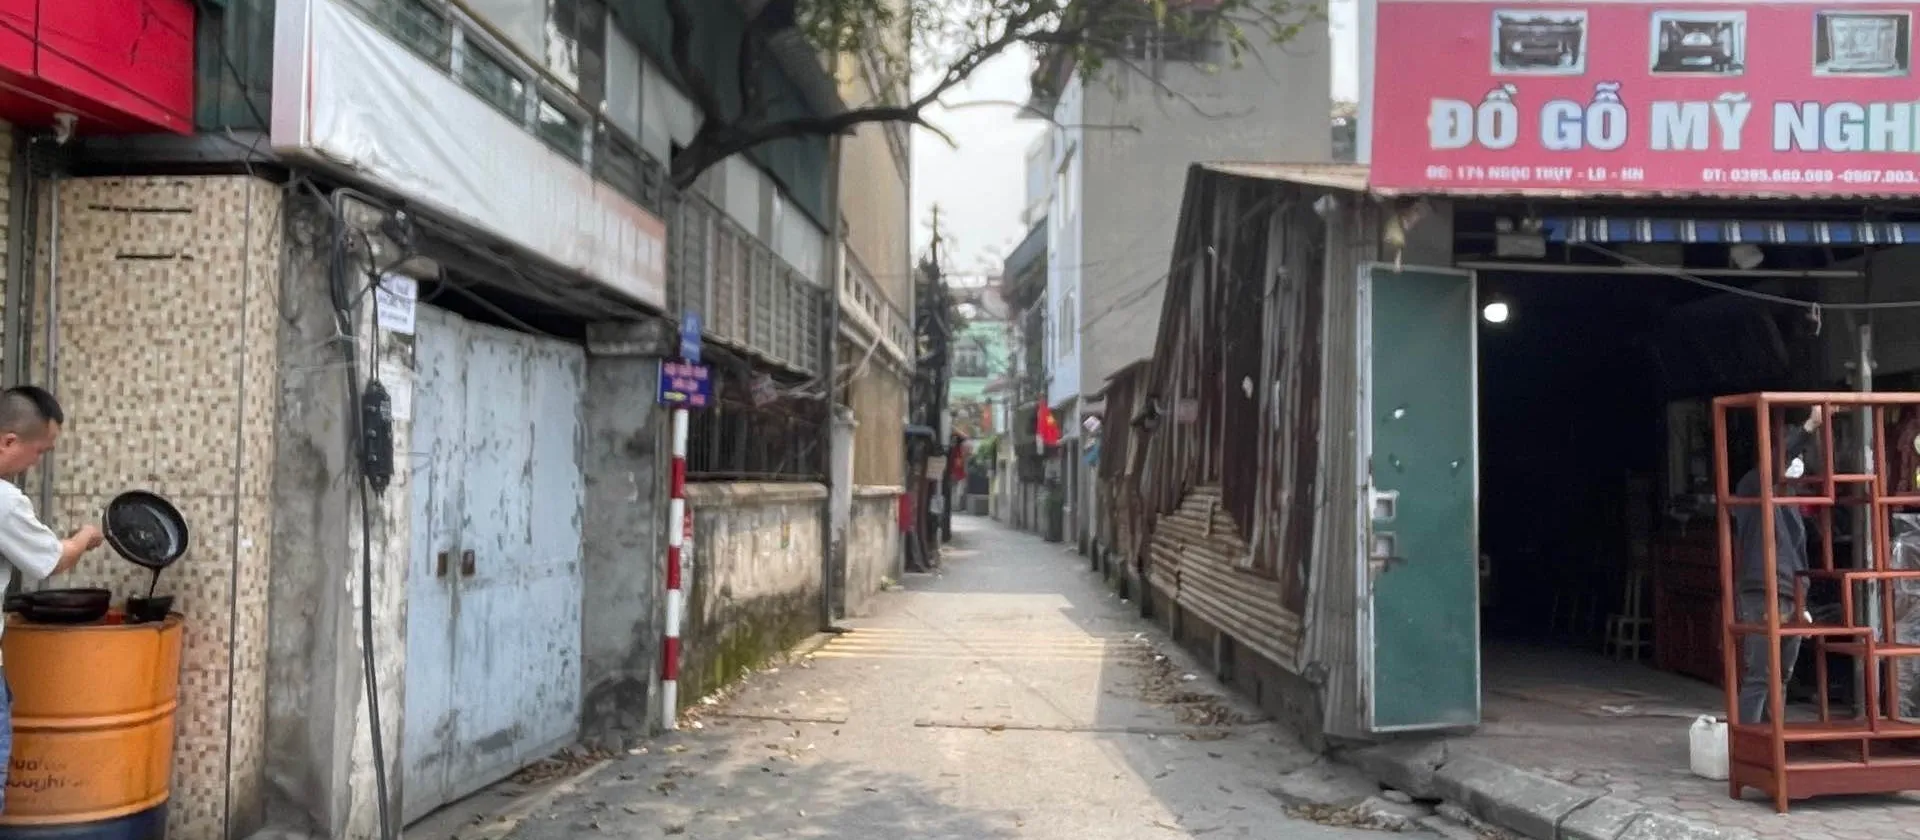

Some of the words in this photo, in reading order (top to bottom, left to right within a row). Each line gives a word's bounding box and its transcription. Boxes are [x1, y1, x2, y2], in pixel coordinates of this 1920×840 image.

[1427, 82, 1519, 151] ĐỒ
[1540, 81, 1630, 151] GỖ
[1649, 90, 1752, 151] MỸ
[1772, 101, 1920, 152] NGH
